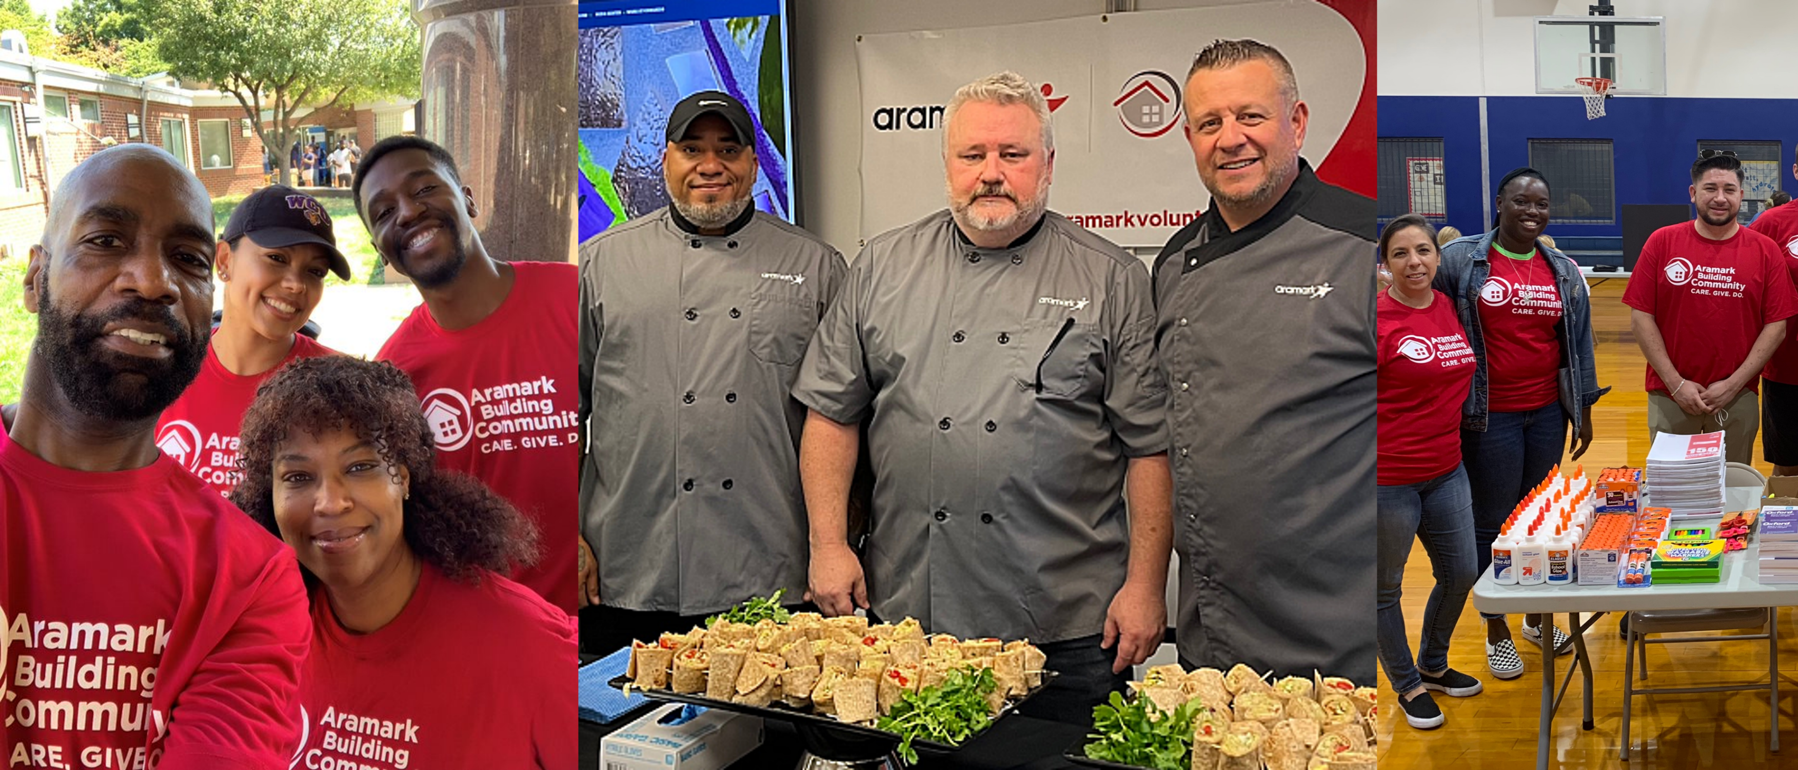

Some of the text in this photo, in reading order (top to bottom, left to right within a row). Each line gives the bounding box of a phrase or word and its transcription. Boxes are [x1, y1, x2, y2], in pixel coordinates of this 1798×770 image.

[1694, 264, 1736, 275] Aramark
[1697, 272, 1732, 282] Building
[1275, 284, 1316, 295] aramark
[1513, 282, 1557, 293] Aramark
[1690, 278, 1746, 292] Community
[1690, 288, 1711, 296] CARE.
[1039, 296, 1075, 308] aramark
[1537, 309, 1557, 317] GIVE.
[1430, 332, 1464, 344] Aramark
[1437, 341, 1468, 352] Building
[1441, 359, 1460, 367] CARE.
[471, 376, 557, 406] Aramark
[480, 398, 554, 420] Building
[474, 410, 578, 438] Communit
[521, 435, 563, 449] GIVE.
[8, 612, 172, 655] Aramark
[14, 655, 156, 698] Building
[320, 705, 420, 744] Aramark
[322, 730, 410, 770] Building
